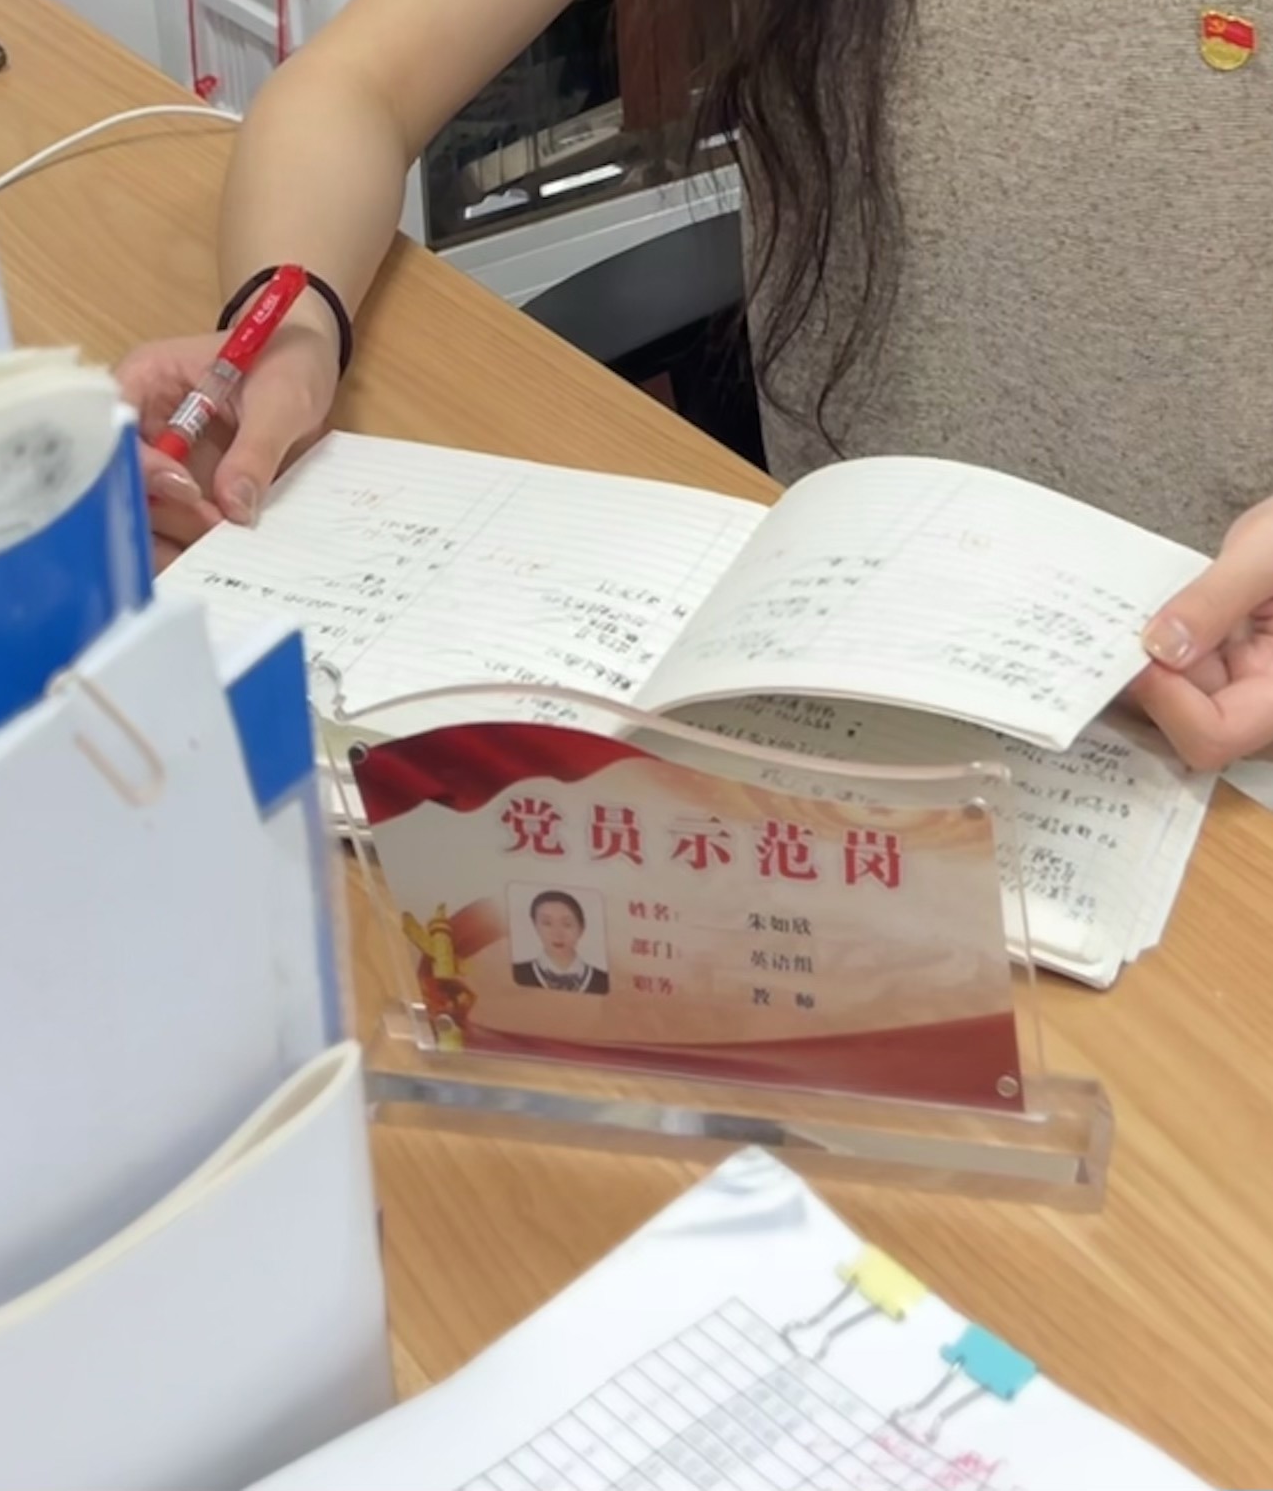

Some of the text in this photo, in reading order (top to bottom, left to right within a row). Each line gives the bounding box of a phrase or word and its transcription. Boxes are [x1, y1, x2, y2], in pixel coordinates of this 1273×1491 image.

[500, 797, 905, 891] 党员示范岗
[750, 949, 815, 974] 英语组
